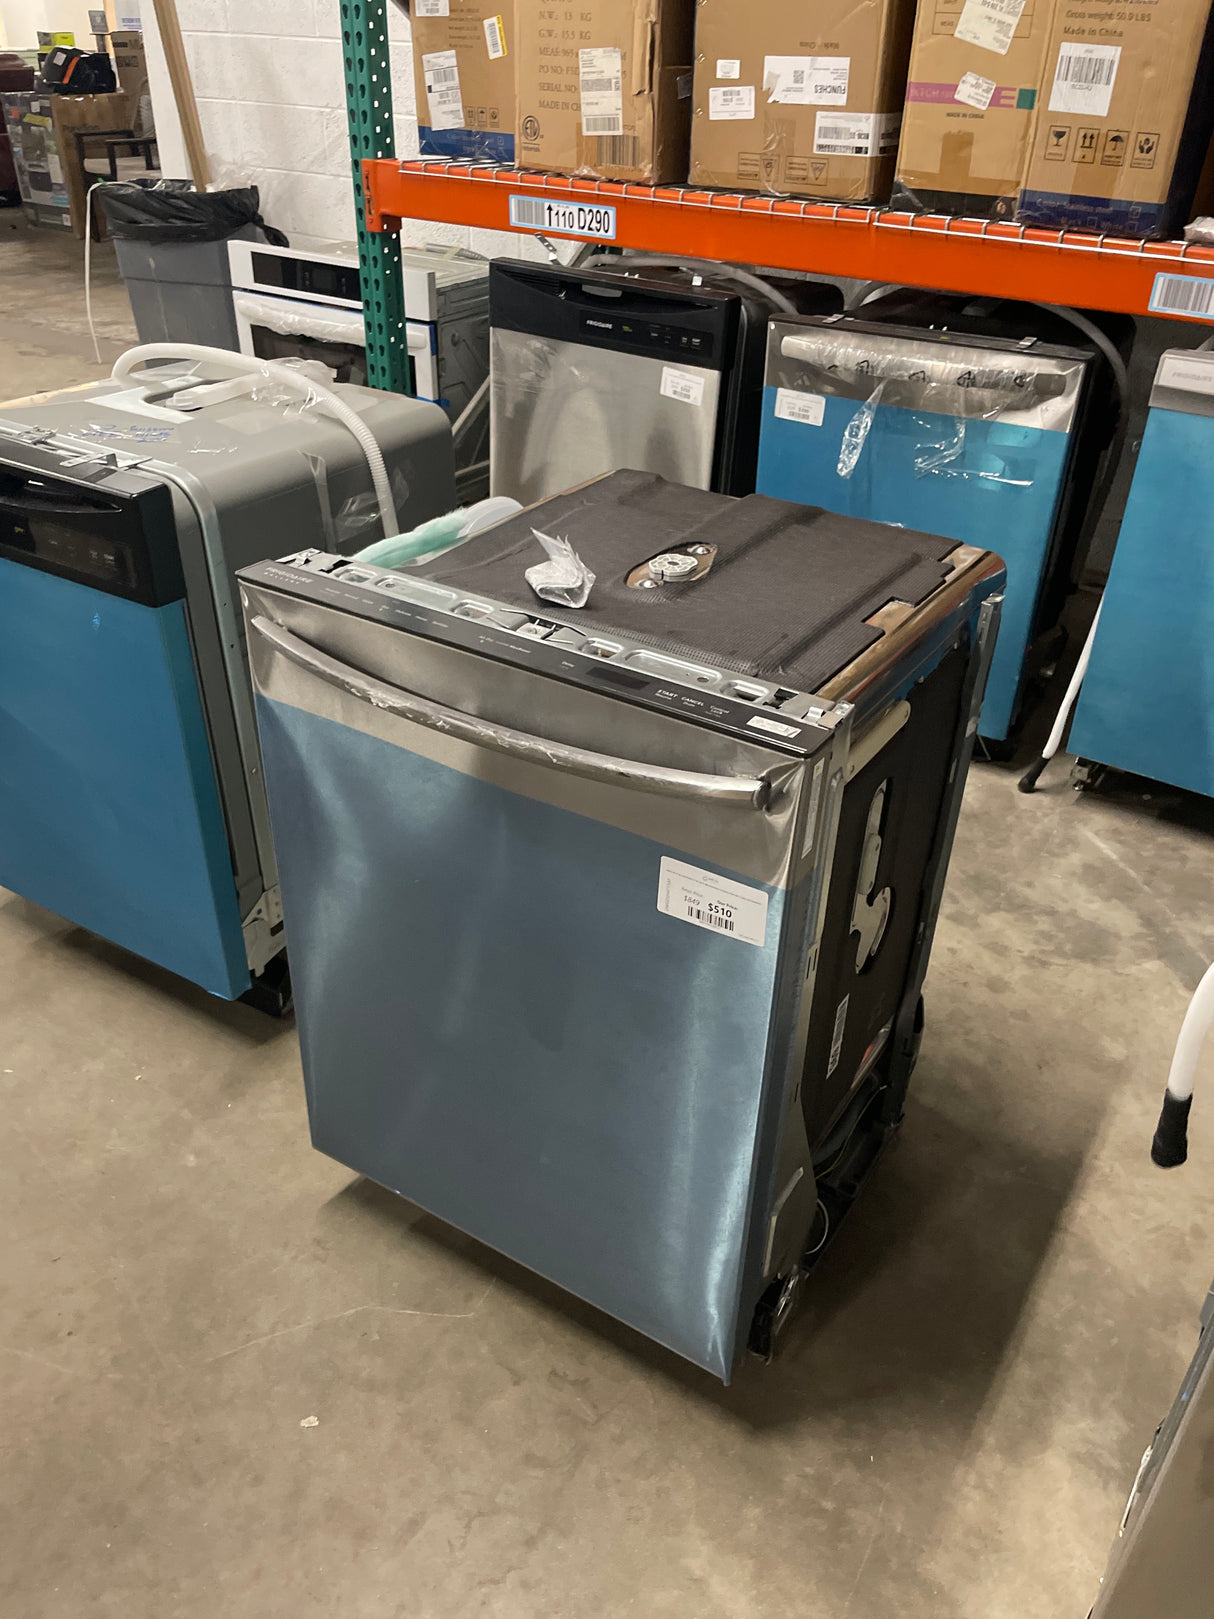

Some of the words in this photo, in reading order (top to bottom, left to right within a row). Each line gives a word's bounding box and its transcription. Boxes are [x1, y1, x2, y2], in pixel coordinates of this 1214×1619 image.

[580, 12, 592, 22] KG
[1135, 13, 1152, 22] LBS
[579, 31, 592, 41] KG
[1063, 26, 1086, 35] Made
[1087, 27, 1097, 36] in
[1098, 27, 1124, 37] China
[814, 84, 846, 95] FUNCHES
[538, 100, 560, 111] MADE
[561, 102, 570, 111] IN
[554, 209, 575, 229] 110
[577, 207, 611, 234] D290
[265, 566, 314, 584] FRIGIDAIRE
[657, 689, 679, 699] START
[681, 696, 705, 707] CANCEL
[707, 902, 733, 919] $510
